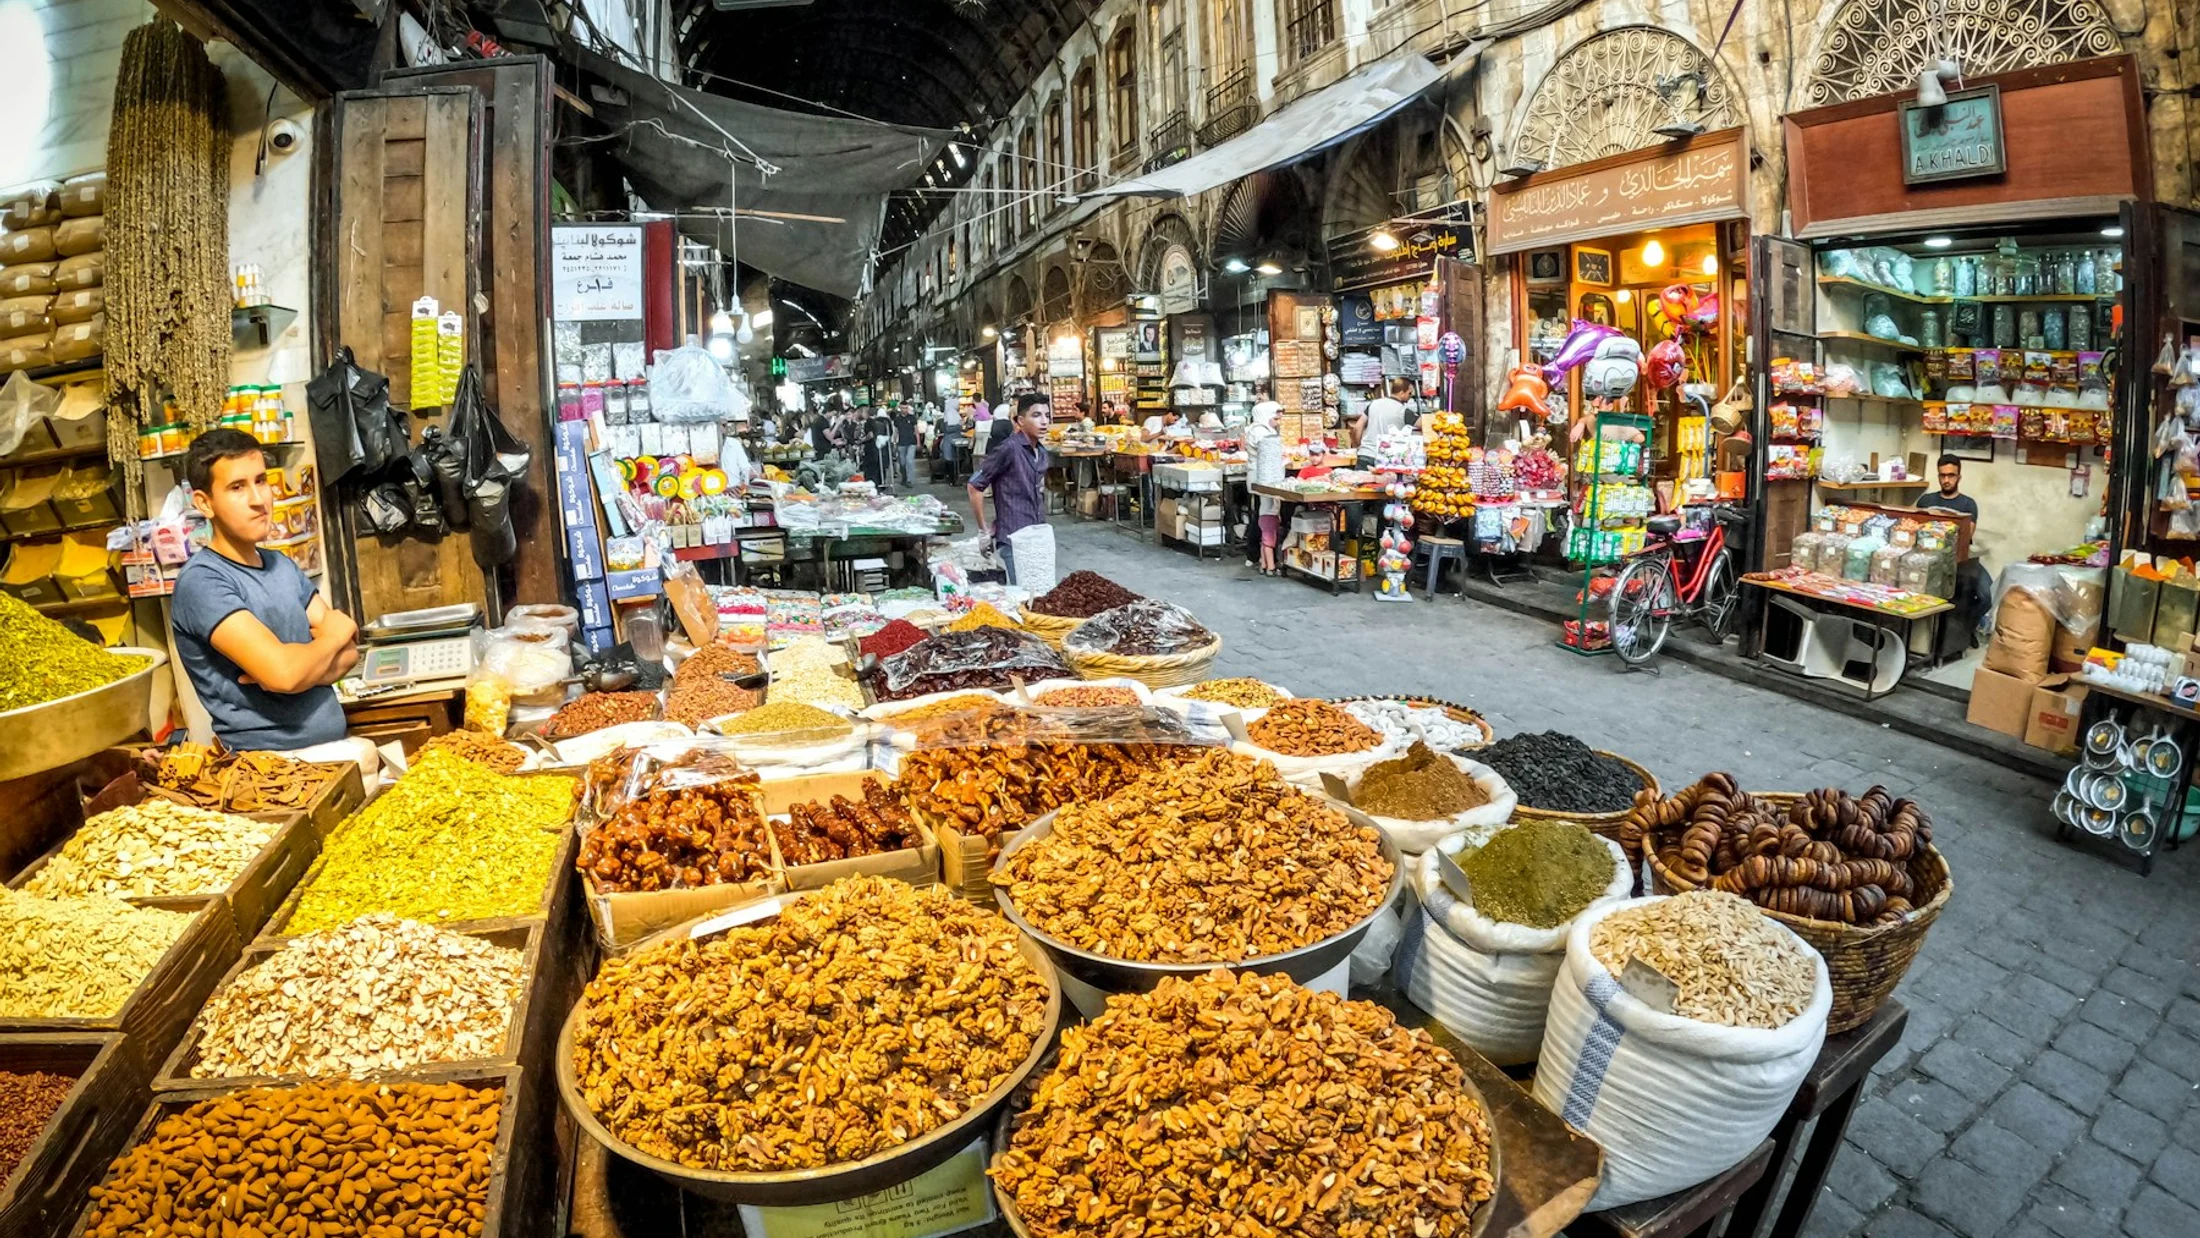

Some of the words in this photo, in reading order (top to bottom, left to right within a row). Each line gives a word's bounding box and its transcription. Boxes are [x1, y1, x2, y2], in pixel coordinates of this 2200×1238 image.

[1619, 157, 1692, 199] الخالدي
[1593, 187, 1608, 207] و
[1701, 190, 1733, 206] شوكولا
[1662, 199, 1694, 213] سكاكر
[591, 232, 637, 247] شوكولا
[606, 253, 627, 261] محمد
